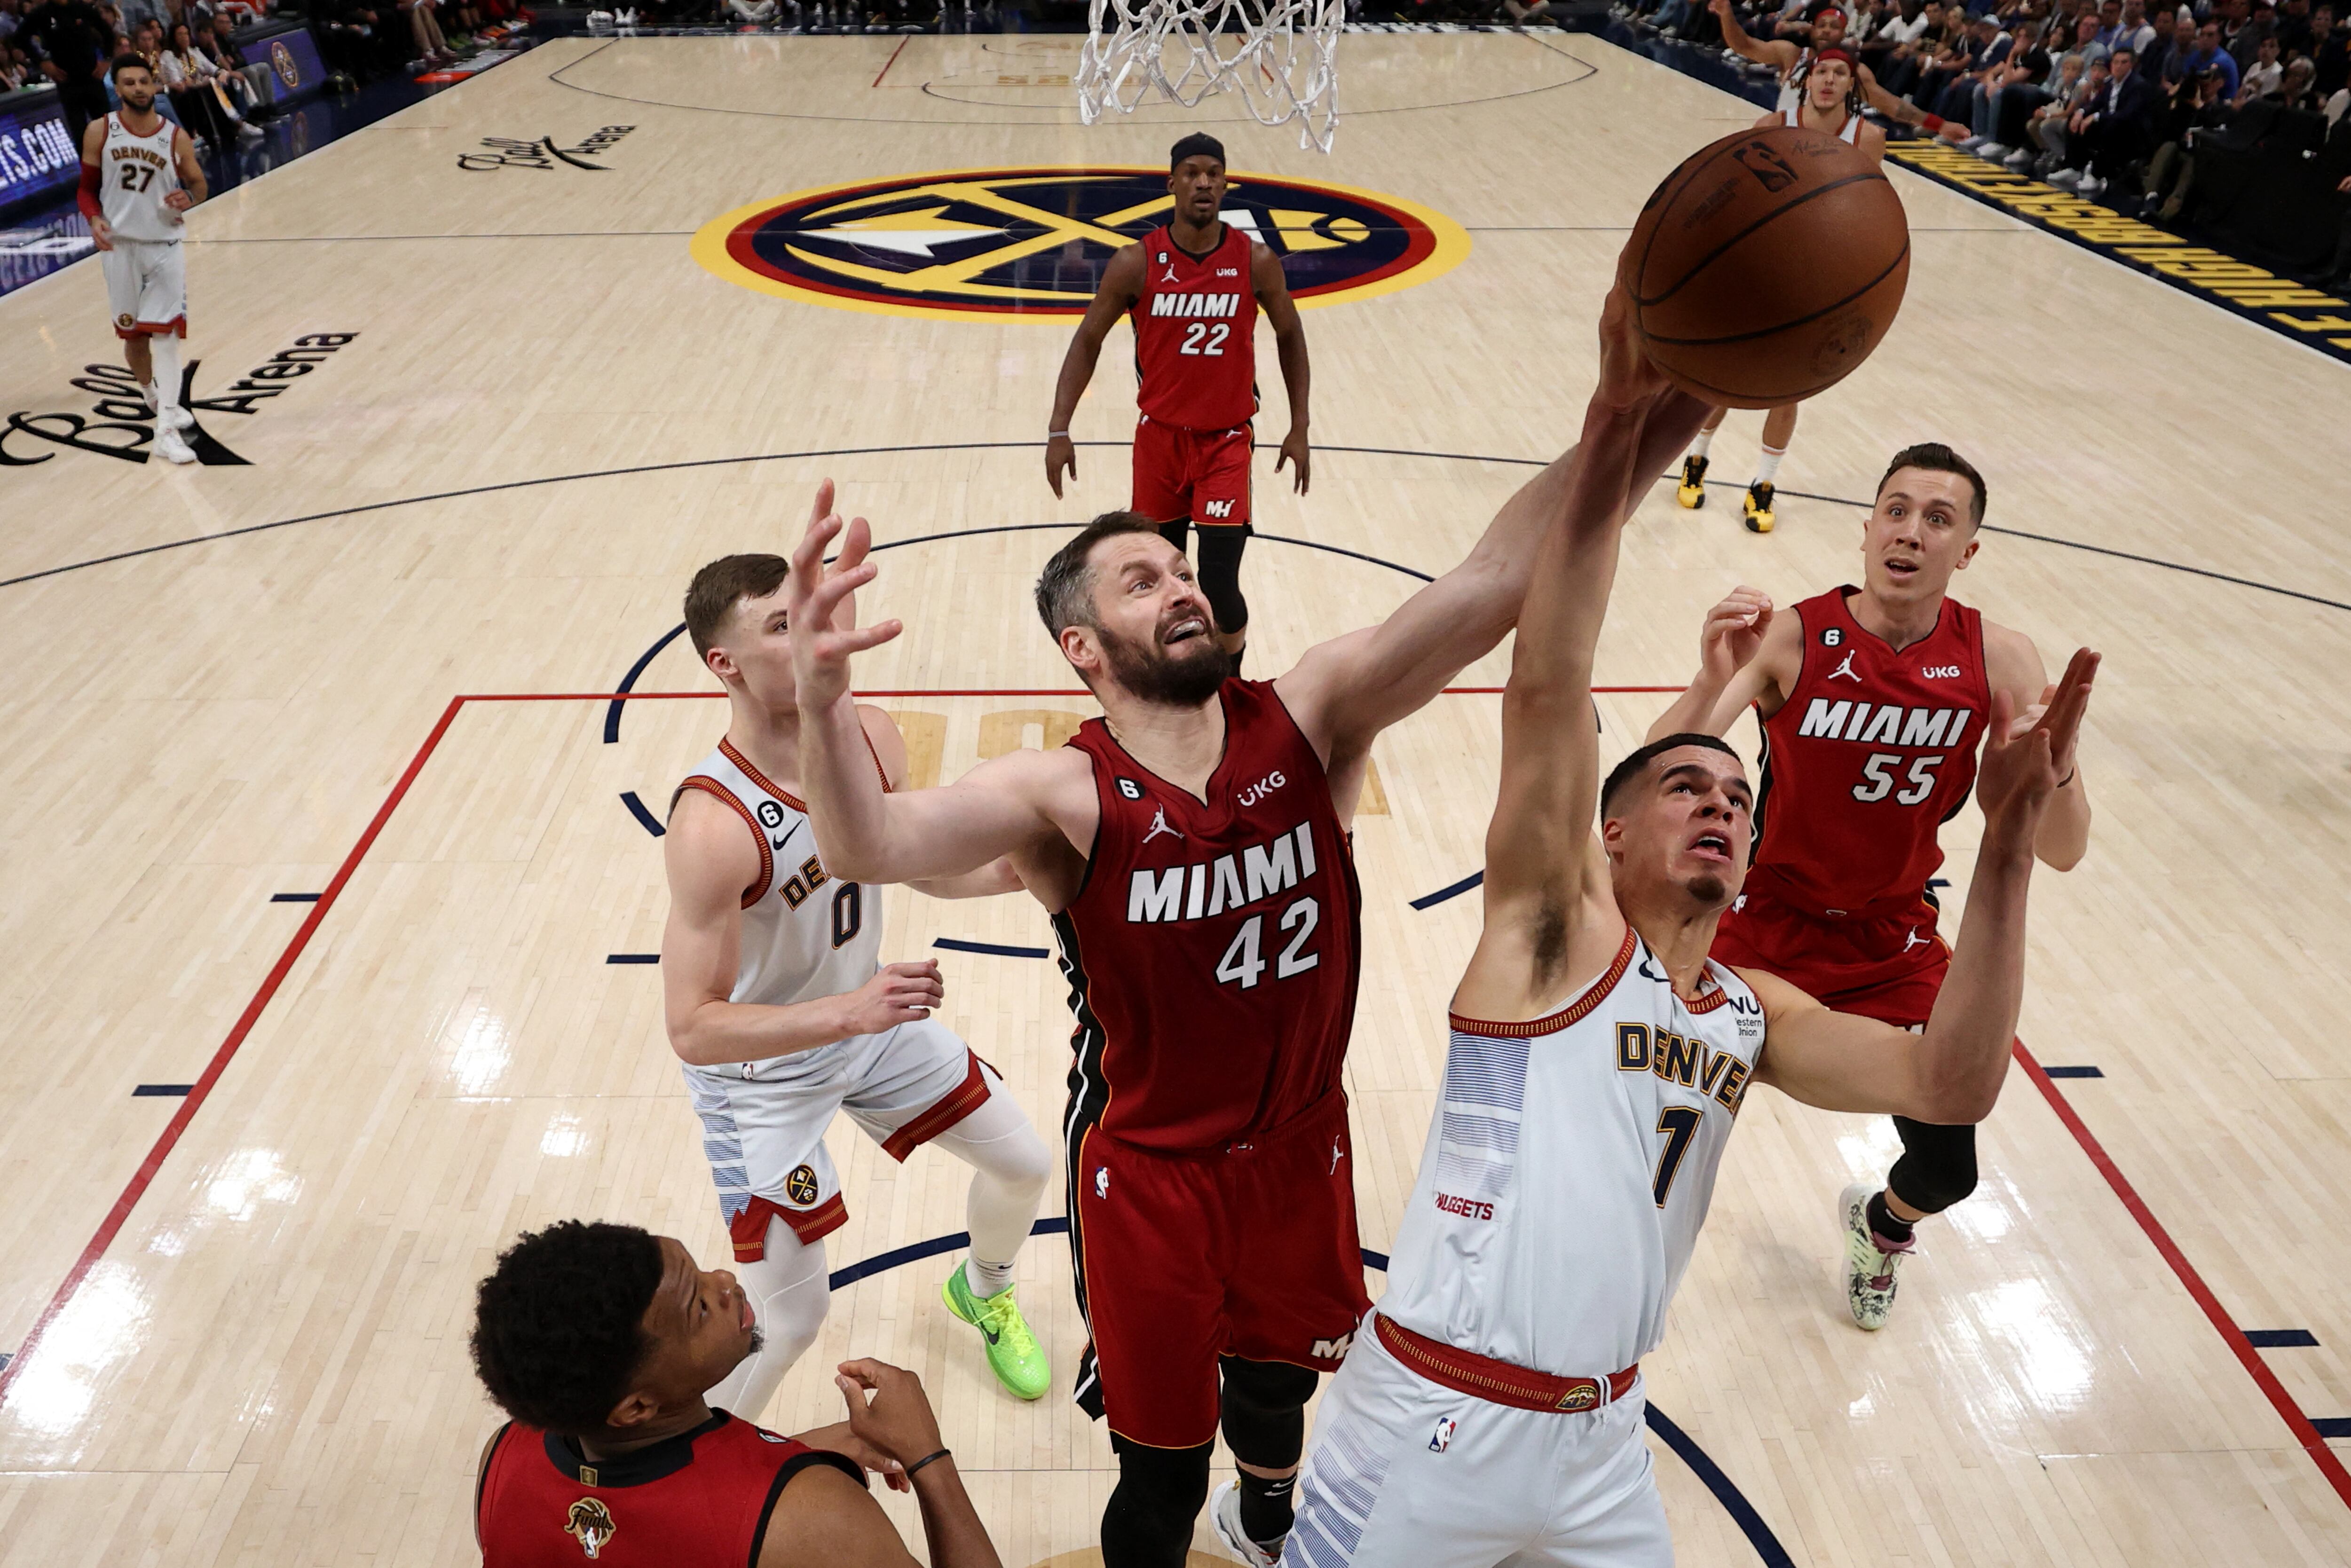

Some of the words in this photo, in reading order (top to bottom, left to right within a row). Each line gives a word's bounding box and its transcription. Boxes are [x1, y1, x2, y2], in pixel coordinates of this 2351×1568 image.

[0, 118, 79, 189] TS.COM
[111, 146, 167, 171] DENVER
[458, 135, 555, 171] Ball
[559, 125, 638, 154] Arena
[122, 163, 155, 193] 27
[1159, 252, 1168, 263] 6
[2114, 247, 2350, 308] HIGH
[1151, 293, 1240, 317] MIAMI
[1180, 322, 1230, 355] 22
[190, 331, 361, 414] Arena
[1825, 629, 1840, 646] 6
[1798, 698, 1972, 747] MIAMI
[1119, 779, 1140, 798] 6
[1852, 753, 1944, 805] 55
[760, 804, 780, 827] 6
[779, 854, 832, 911] DE
[1128, 820, 1317, 922] MIAMI
[831, 881, 862, 950] 0
[1216, 896, 1318, 989] 42
[1735, 1017, 1762, 1027] estern
[1616, 1022, 1749, 1121] DENVE
[1652, 1105, 1704, 1209] 1
[1435, 1191, 1494, 1221] NUGGETS
